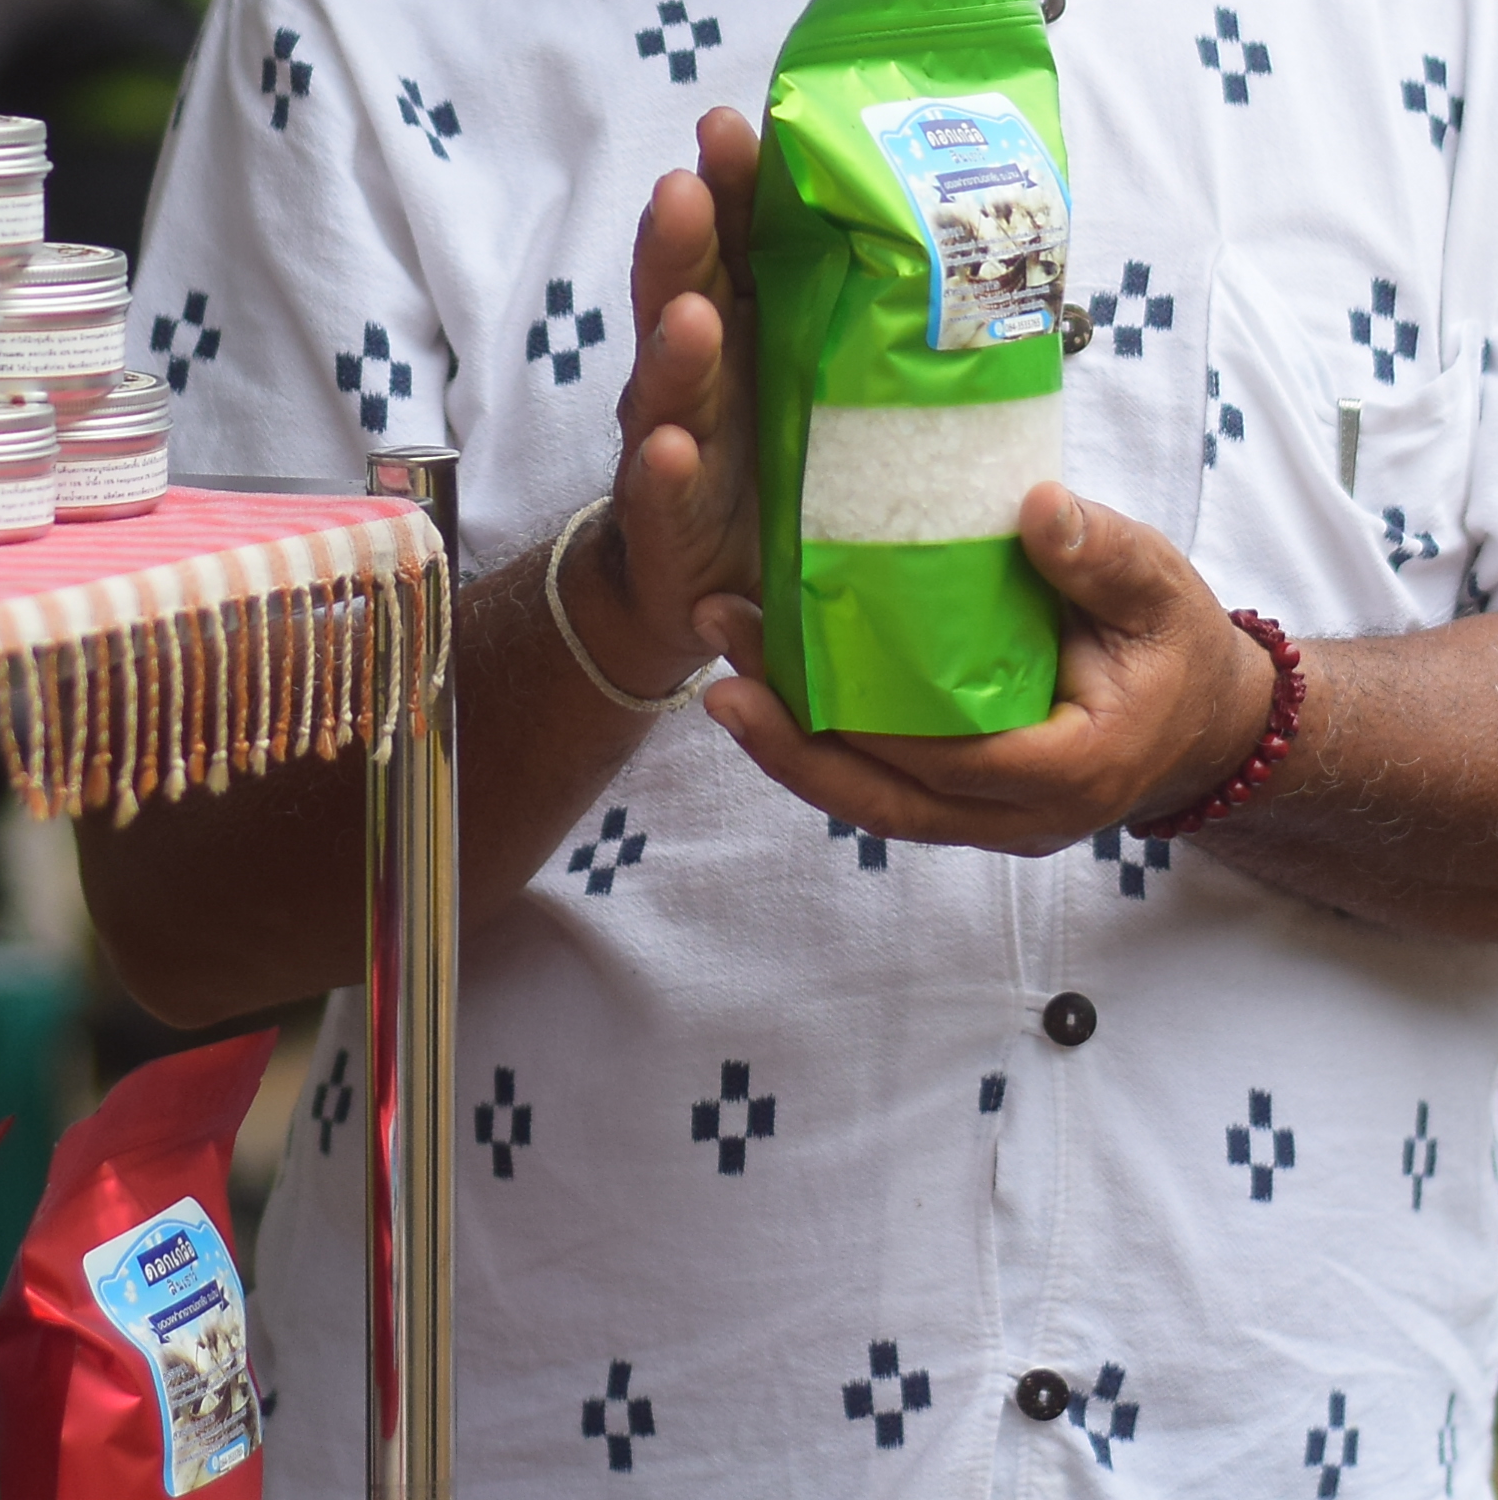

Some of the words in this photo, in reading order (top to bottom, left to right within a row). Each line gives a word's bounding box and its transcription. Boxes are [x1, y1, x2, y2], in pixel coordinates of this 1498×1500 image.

[926, 122, 985, 148] ดอกเกลือ
[144, 1236, 196, 1282] ดอกเกลือ
